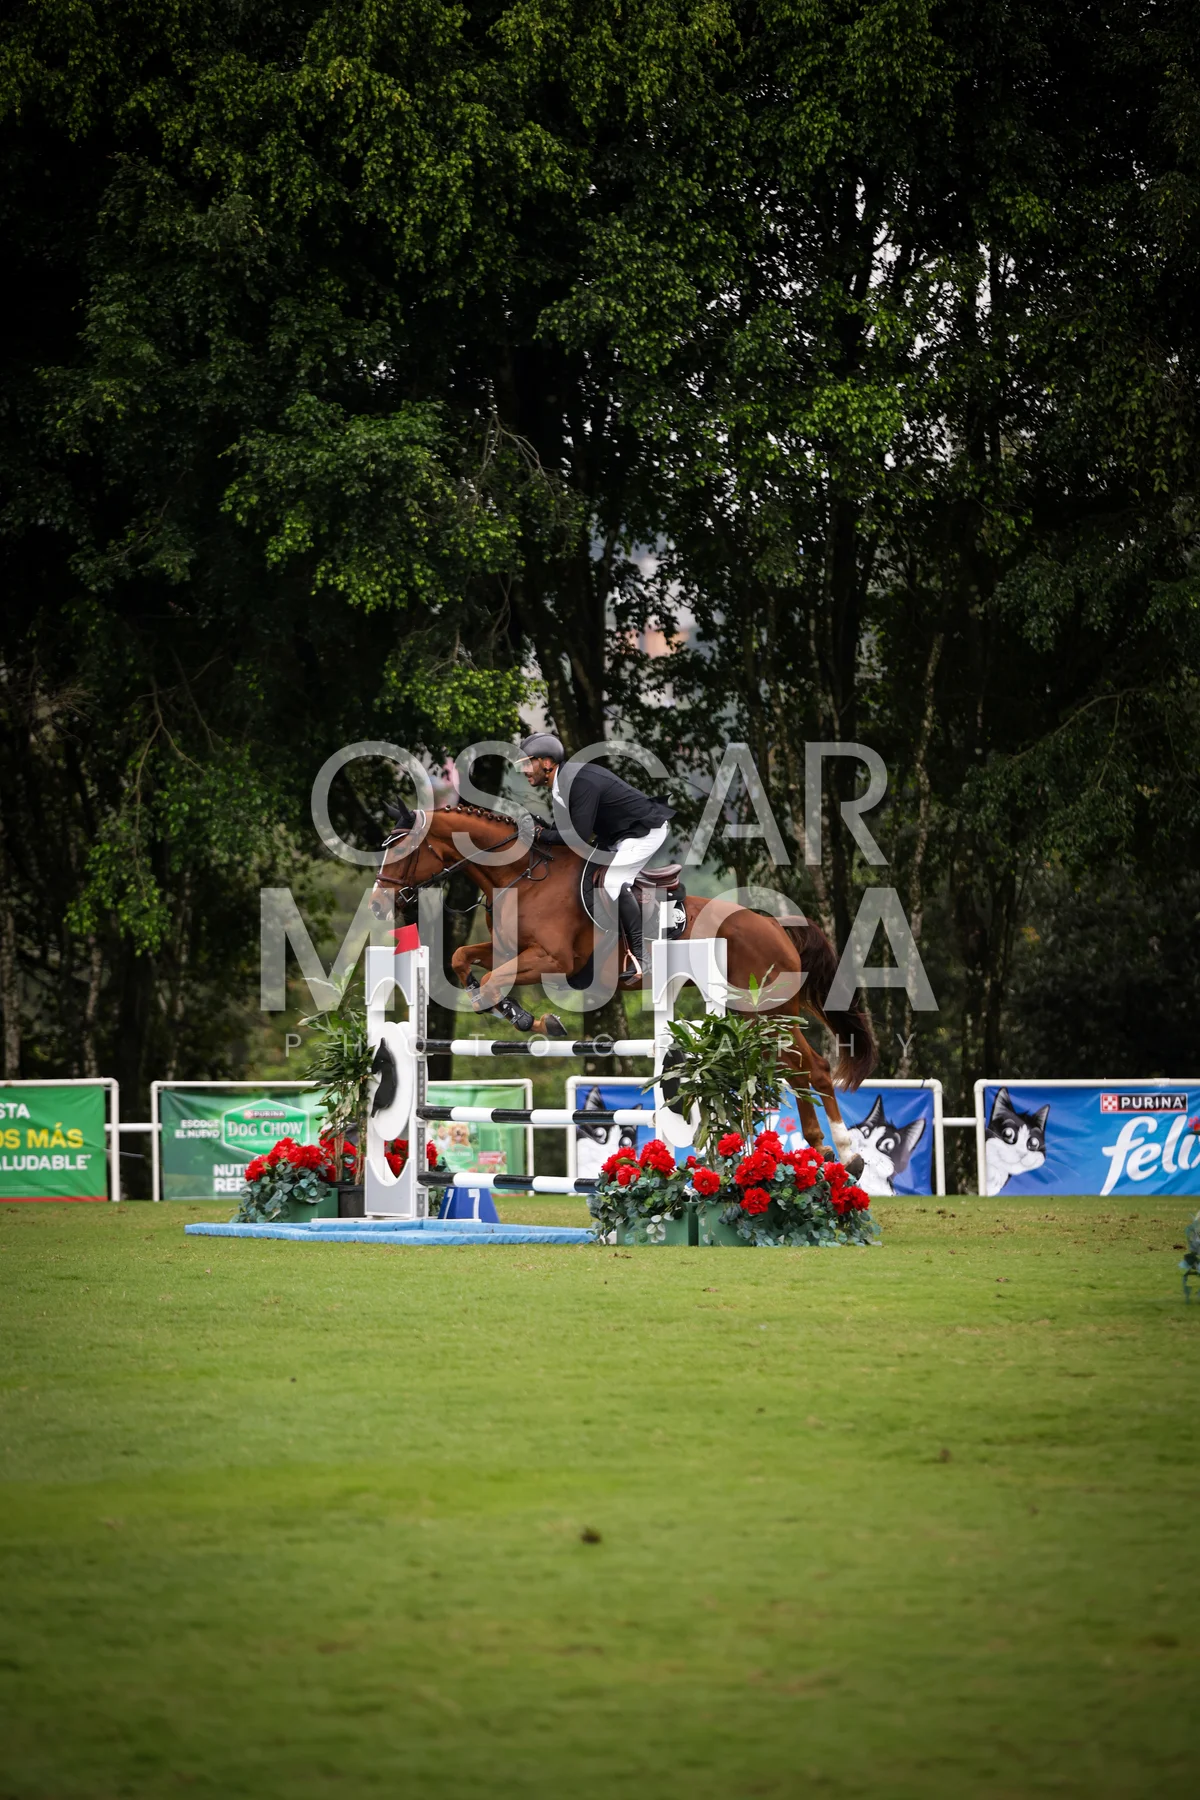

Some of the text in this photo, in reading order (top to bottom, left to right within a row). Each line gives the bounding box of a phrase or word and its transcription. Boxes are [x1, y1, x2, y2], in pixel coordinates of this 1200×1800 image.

[1121, 1096, 1183, 1109] PURINA
[26, 1122, 84, 1149] MÁS
[174, 1129, 221, 1139] EL NUEVO
[0, 1154, 92, 1171] LUDABLE
